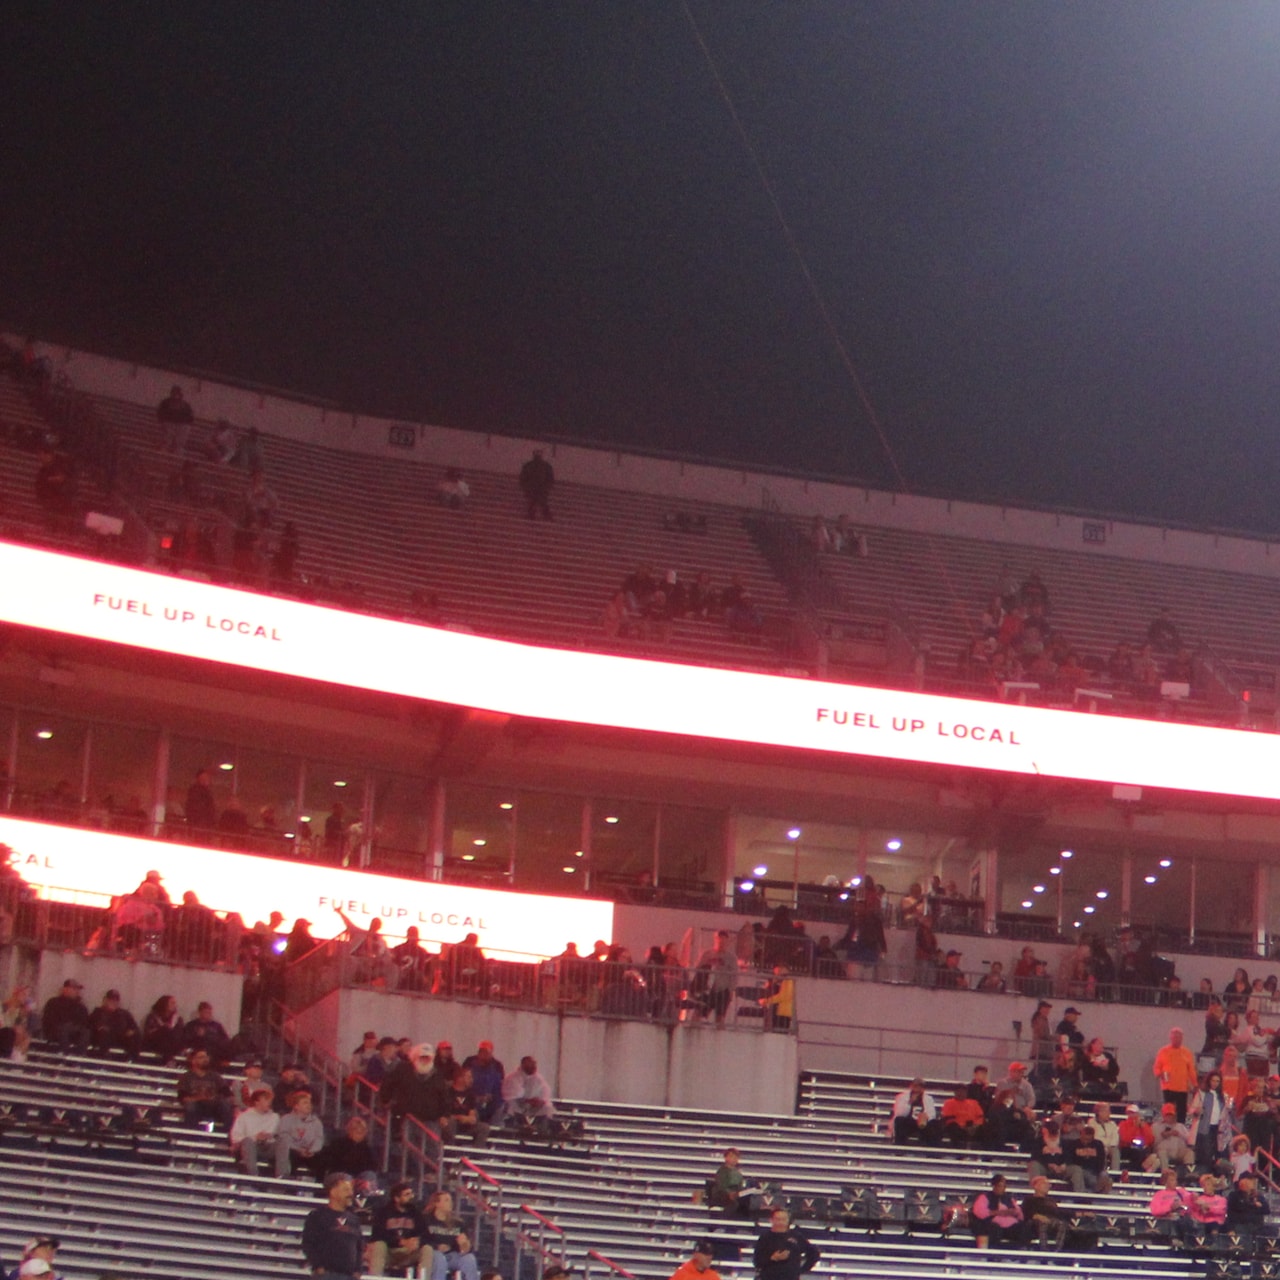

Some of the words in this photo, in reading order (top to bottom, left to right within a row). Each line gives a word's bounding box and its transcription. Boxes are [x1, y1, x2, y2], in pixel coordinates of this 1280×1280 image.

[93, 593, 153, 616] FUEL
[164, 607, 195, 623] UP
[206, 615, 282, 641] LOCAL
[816, 708, 880, 729] FUEL
[892, 717, 925, 733] UP
[937, 722, 1021, 745] LOCAL
[9, 851, 54, 869] CAL
[318, 896, 370, 914] FUEL
[381, 905, 408, 918] UP
[419, 911, 487, 929] LOCAL
